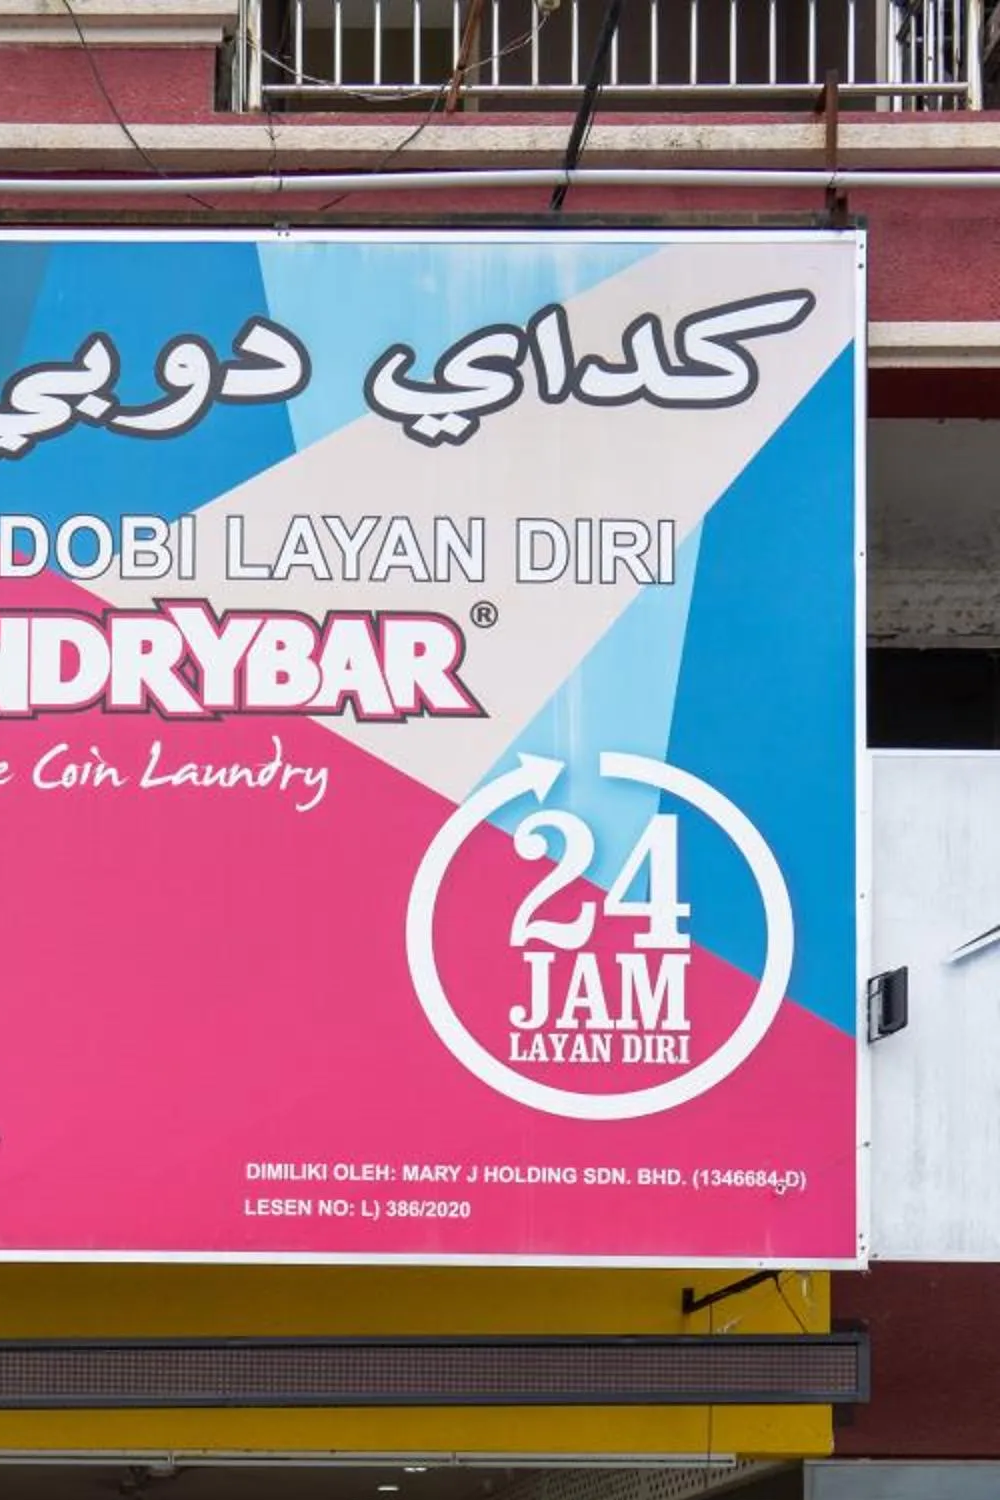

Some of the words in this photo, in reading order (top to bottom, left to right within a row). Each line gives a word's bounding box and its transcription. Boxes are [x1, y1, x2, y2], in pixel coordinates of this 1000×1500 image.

[225, 514, 486, 582] LAYAN
[515, 517, 676, 585] DIRI
[32, 743, 128, 790] Coin
[139, 735, 329, 812] Laundry
[509, 808, 691, 950] 24
[508, 951, 692, 1031] JAM
[508, 1031, 612, 1063] LAYAN
[621, 1034, 691, 1065] DIRI
[244, 1198, 312, 1217] LESEN
[318, 1199, 355, 1217] NO:
[386, 1200, 472, 1219] 386/2020
[246, 1162, 328, 1181] DIMILIKI
[333, 1163, 397, 1182] OLEH:
[402, 1164, 462, 1183] MARY
[466, 1164, 478, 1183] J
[484, 1165, 578, 1185] HOLDING
[583, 1167, 632, 1186] SDN.
[637, 1168, 687, 1186] BHD.
